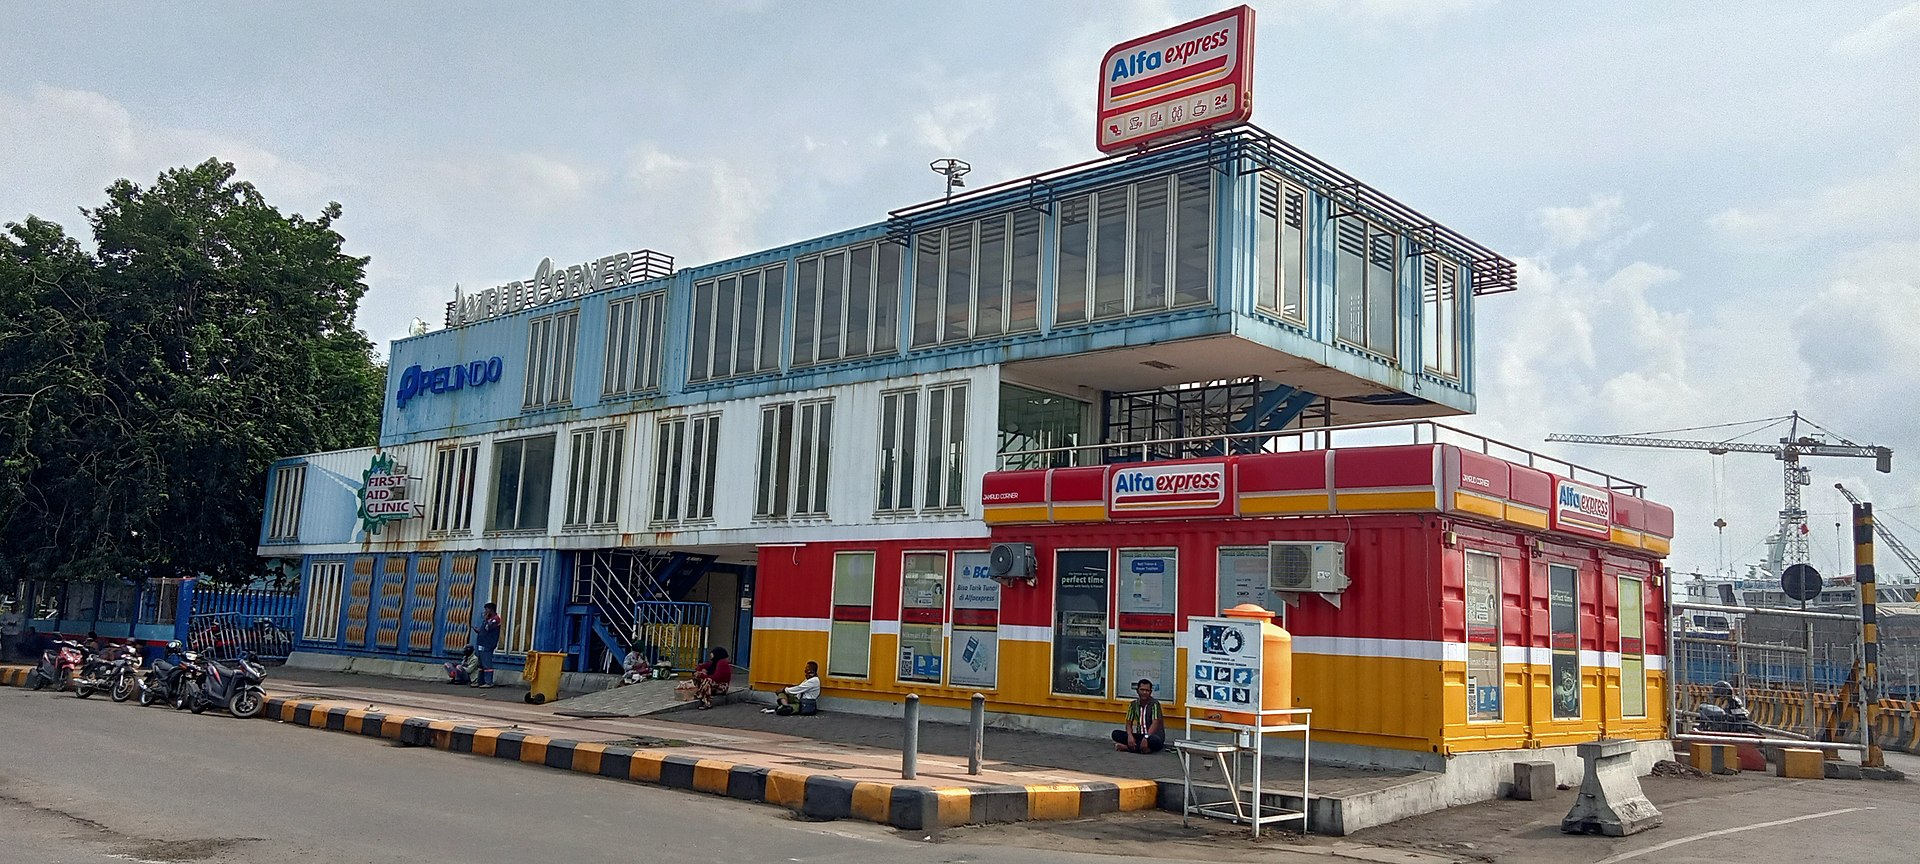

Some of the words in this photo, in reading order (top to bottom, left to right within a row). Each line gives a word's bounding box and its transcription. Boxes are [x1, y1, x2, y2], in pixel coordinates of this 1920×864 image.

[1111, 50, 1162, 82] Alfa
[1164, 28, 1229, 64] express
[1214, 93, 1228, 106] 24
[531, 256, 634, 307] CORNER
[418, 356, 503, 396] PELINDO
[368, 475, 405, 487] FIRST
[1115, 473, 1154, 493] Alfa
[1155, 472, 1220, 493] express
[365, 490, 389, 500] AID
[1559, 485, 1580, 508] Alfa
[1580, 493, 1609, 517] express
[366, 502, 410, 513] CLINIC
[1061, 575, 1087, 585] perfect
[1087, 575, 1105, 584] time
[965, 594, 995, 602] Alfaexpress
